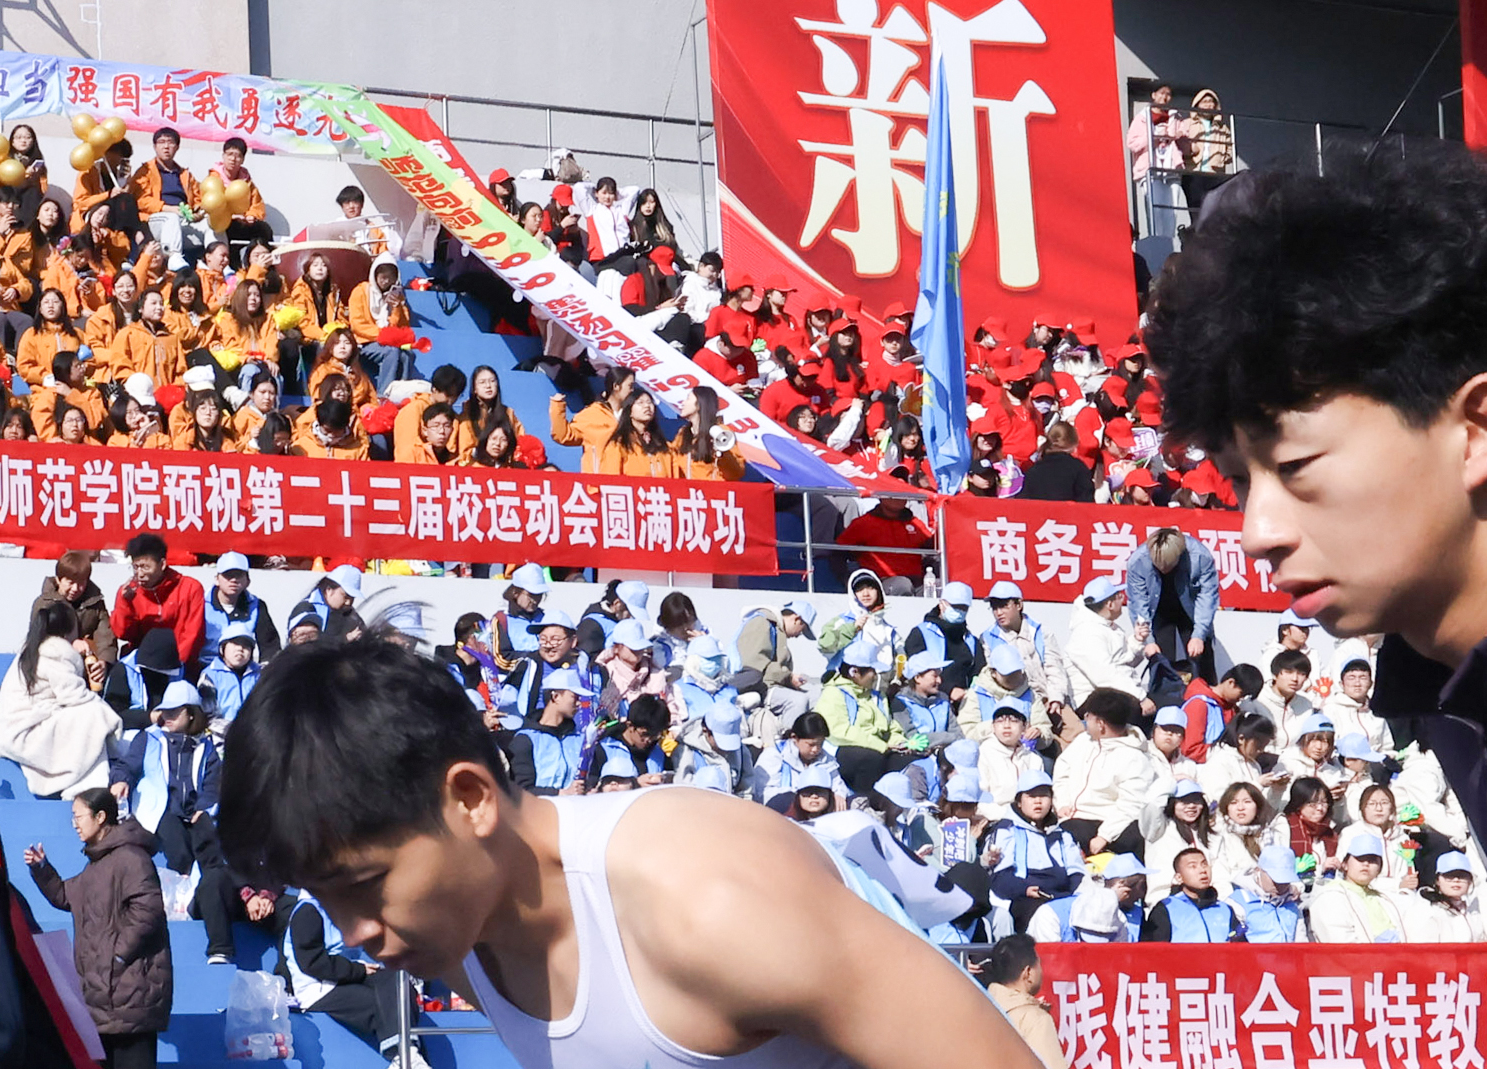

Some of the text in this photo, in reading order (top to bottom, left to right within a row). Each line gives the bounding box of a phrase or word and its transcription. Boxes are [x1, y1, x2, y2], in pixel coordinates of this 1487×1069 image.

[795, 0, 1055, 290] 新
[977, 517, 1278, 593] 商务学预
